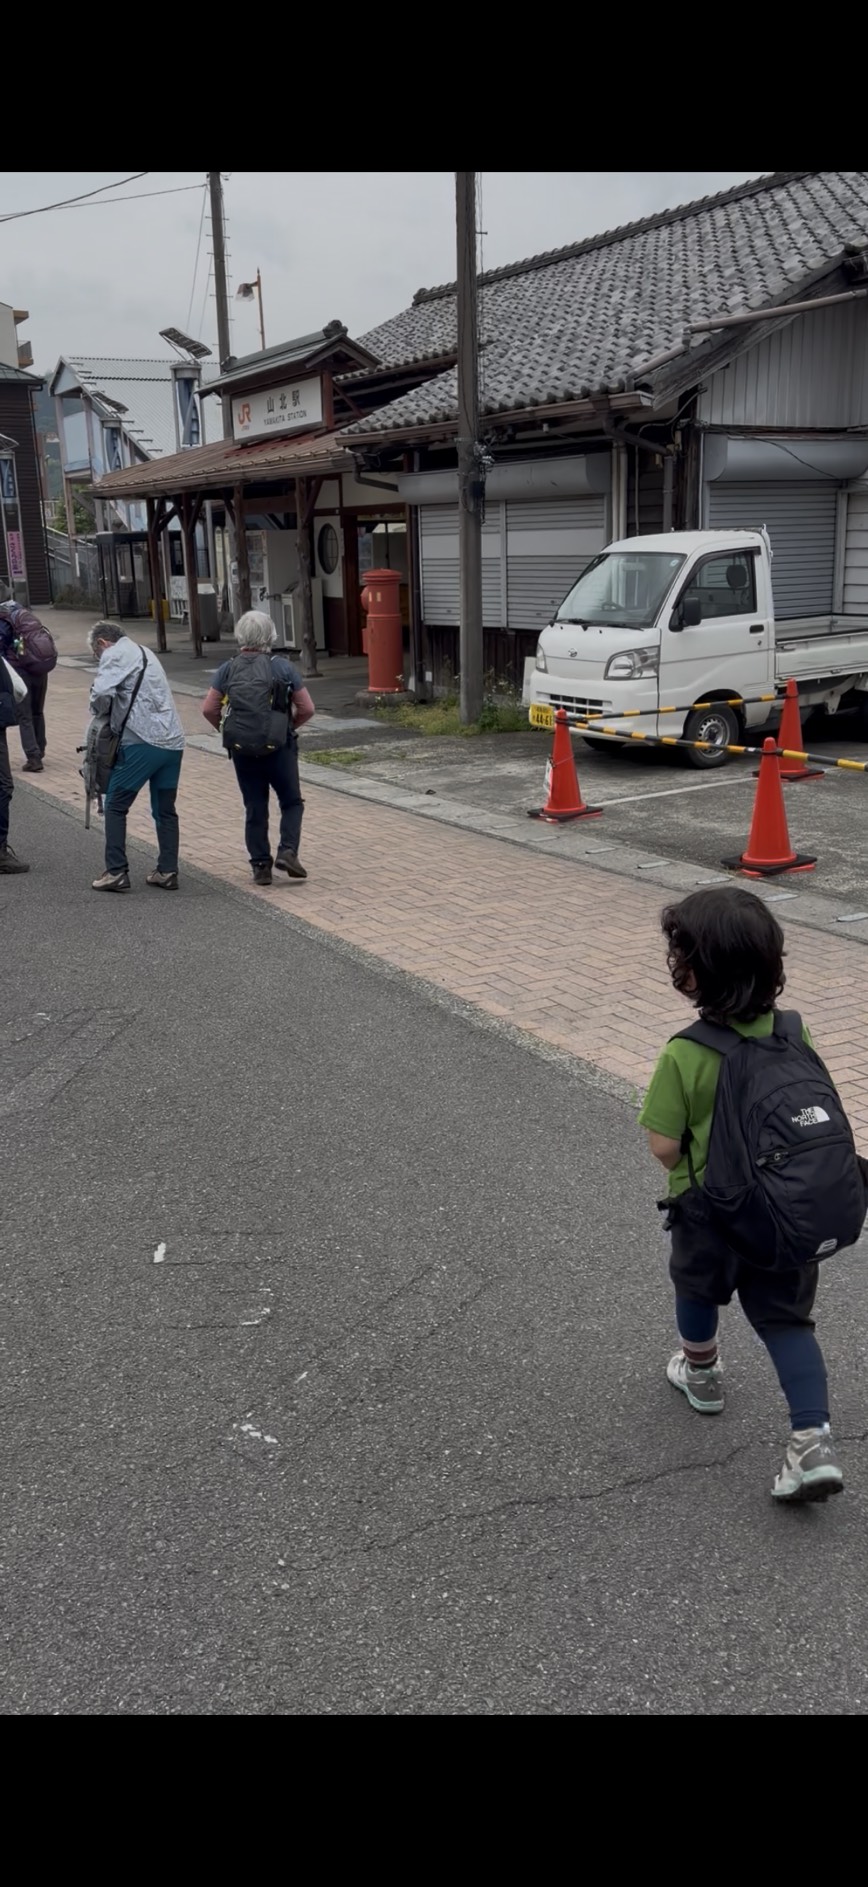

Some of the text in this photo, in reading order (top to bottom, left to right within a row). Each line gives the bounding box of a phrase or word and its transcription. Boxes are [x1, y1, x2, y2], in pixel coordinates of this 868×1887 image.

[267, 389, 300, 413] 山北駅
[238, 402, 251, 425] JR
[287, 410, 307, 421] STATION
[791, 1112, 816, 1123] NORTH
[801, 1108, 814, 1116] THE
[800, 1117, 818, 1127] FACE
